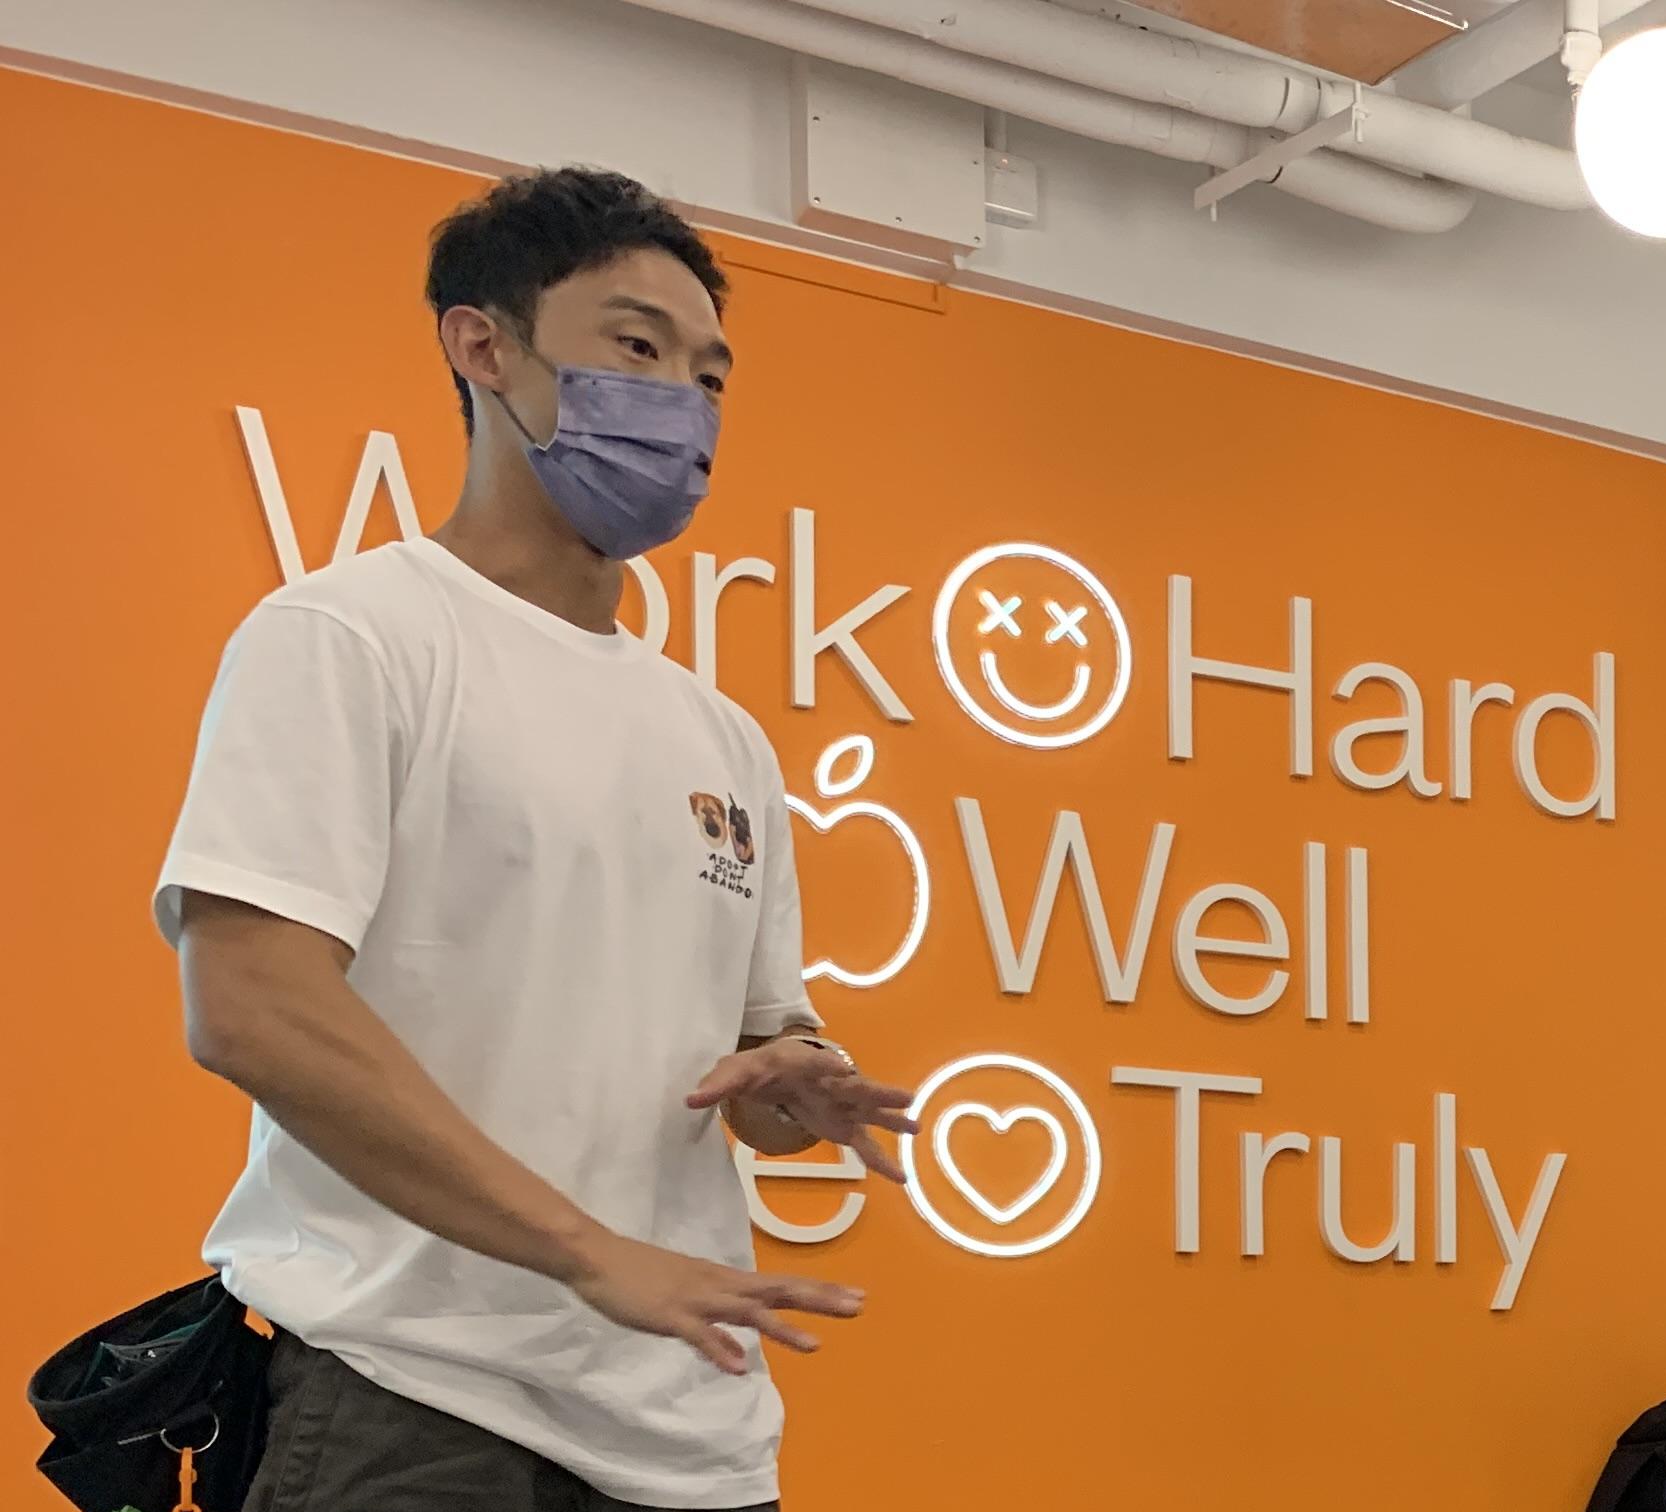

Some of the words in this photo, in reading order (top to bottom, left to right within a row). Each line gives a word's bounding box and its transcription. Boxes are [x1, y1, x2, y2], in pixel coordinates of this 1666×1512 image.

[1166, 574, 1616, 821] Hard
[955, 797, 1370, 1024] Well
[1110, 1066, 1567, 1311] Truly
